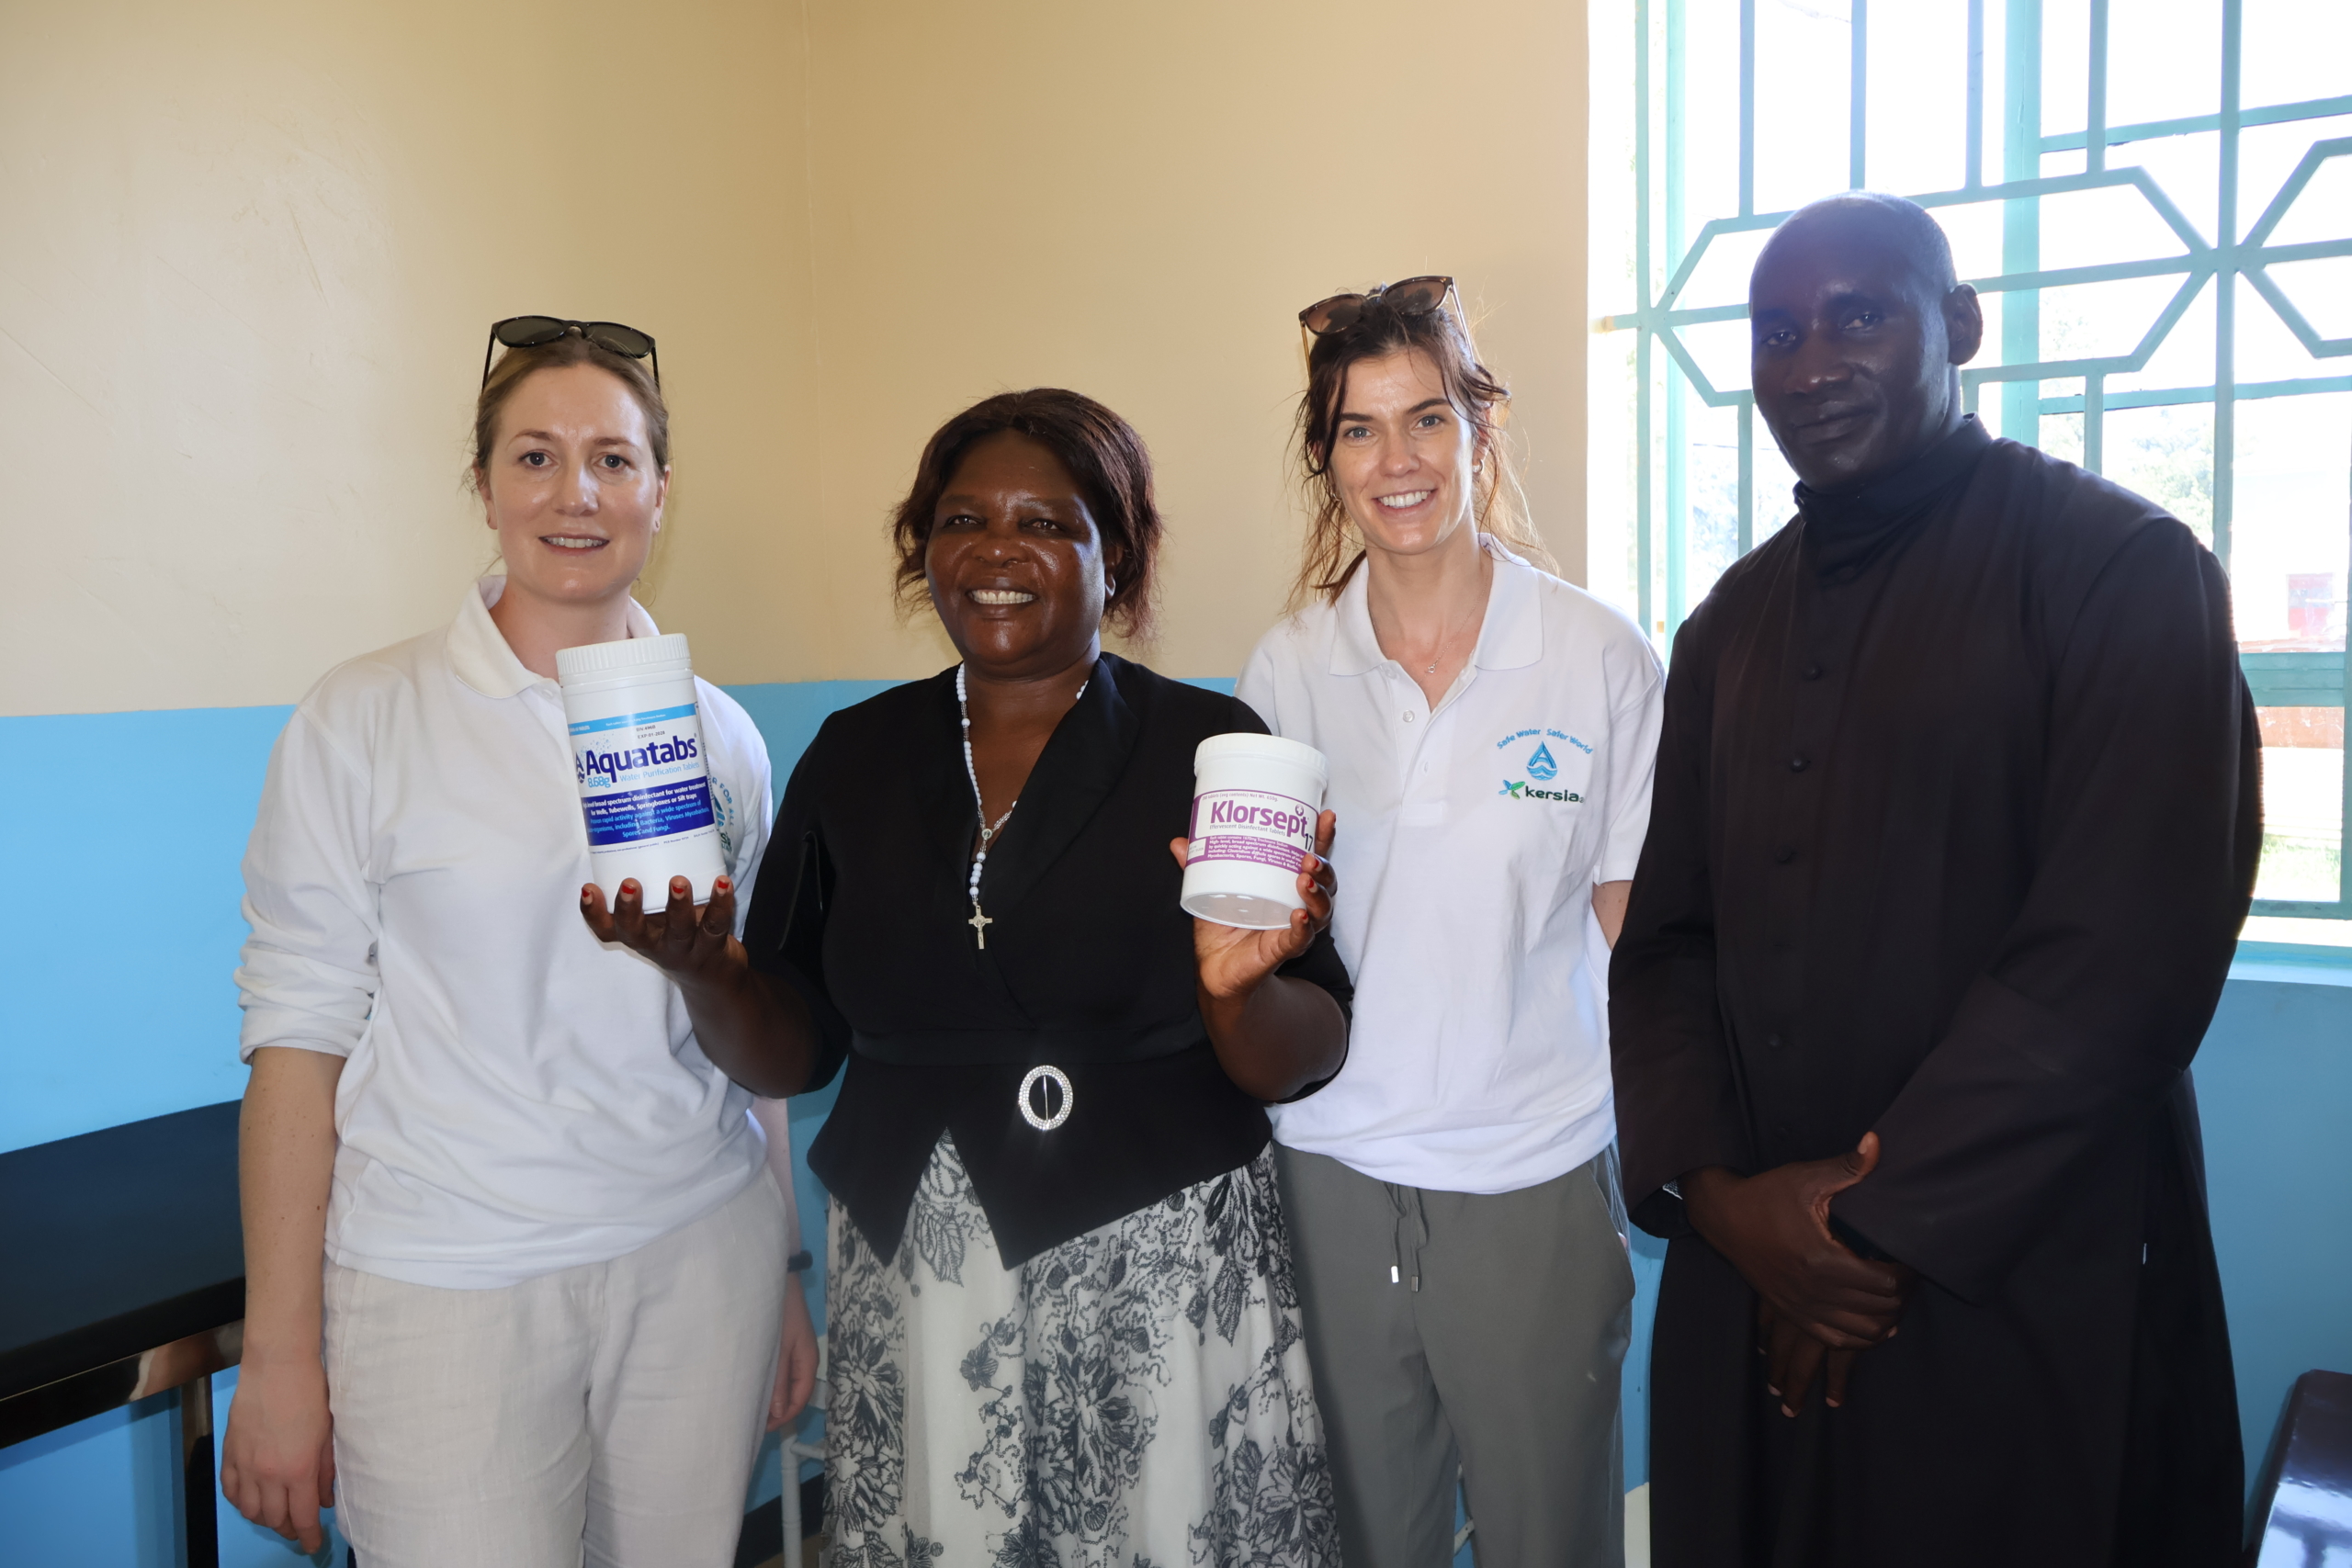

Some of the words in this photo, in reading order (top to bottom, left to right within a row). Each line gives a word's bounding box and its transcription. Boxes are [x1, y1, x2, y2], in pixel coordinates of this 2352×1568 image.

[1497, 735, 1516, 750] Safe
[1516, 728, 1541, 738] Water
[1546, 728, 1569, 740] Safer
[1569, 736, 1594, 754] World
[586, 735, 697, 783] Aquatabs
[619, 773, 641, 782] Water
[643, 765, 682, 778] Purification
[683, 761, 700, 772] Tablets
[607, 796, 632, 807] spectrum
[632, 790, 665, 801] disinfectant
[674, 785, 689, 794] water
[689, 782, 706, 790] treatment
[719, 783, 733, 804] FOR
[1525, 785, 1579, 802] kersia
[608, 804, 636, 813] Tubewells,
[637, 798, 671, 810] Springboxes
[634, 809, 655, 819] against
[675, 802, 697, 812] spectrum
[640, 817, 665, 825] Bacteria,
[665, 813, 684, 821] Viruses
[1210, 800, 1308, 838] Klorsept
[1305, 833, 1313, 852] 17
[1238, 824, 1268, 832] Disinfectant
[1269, 828, 1286, 836] Tablets
